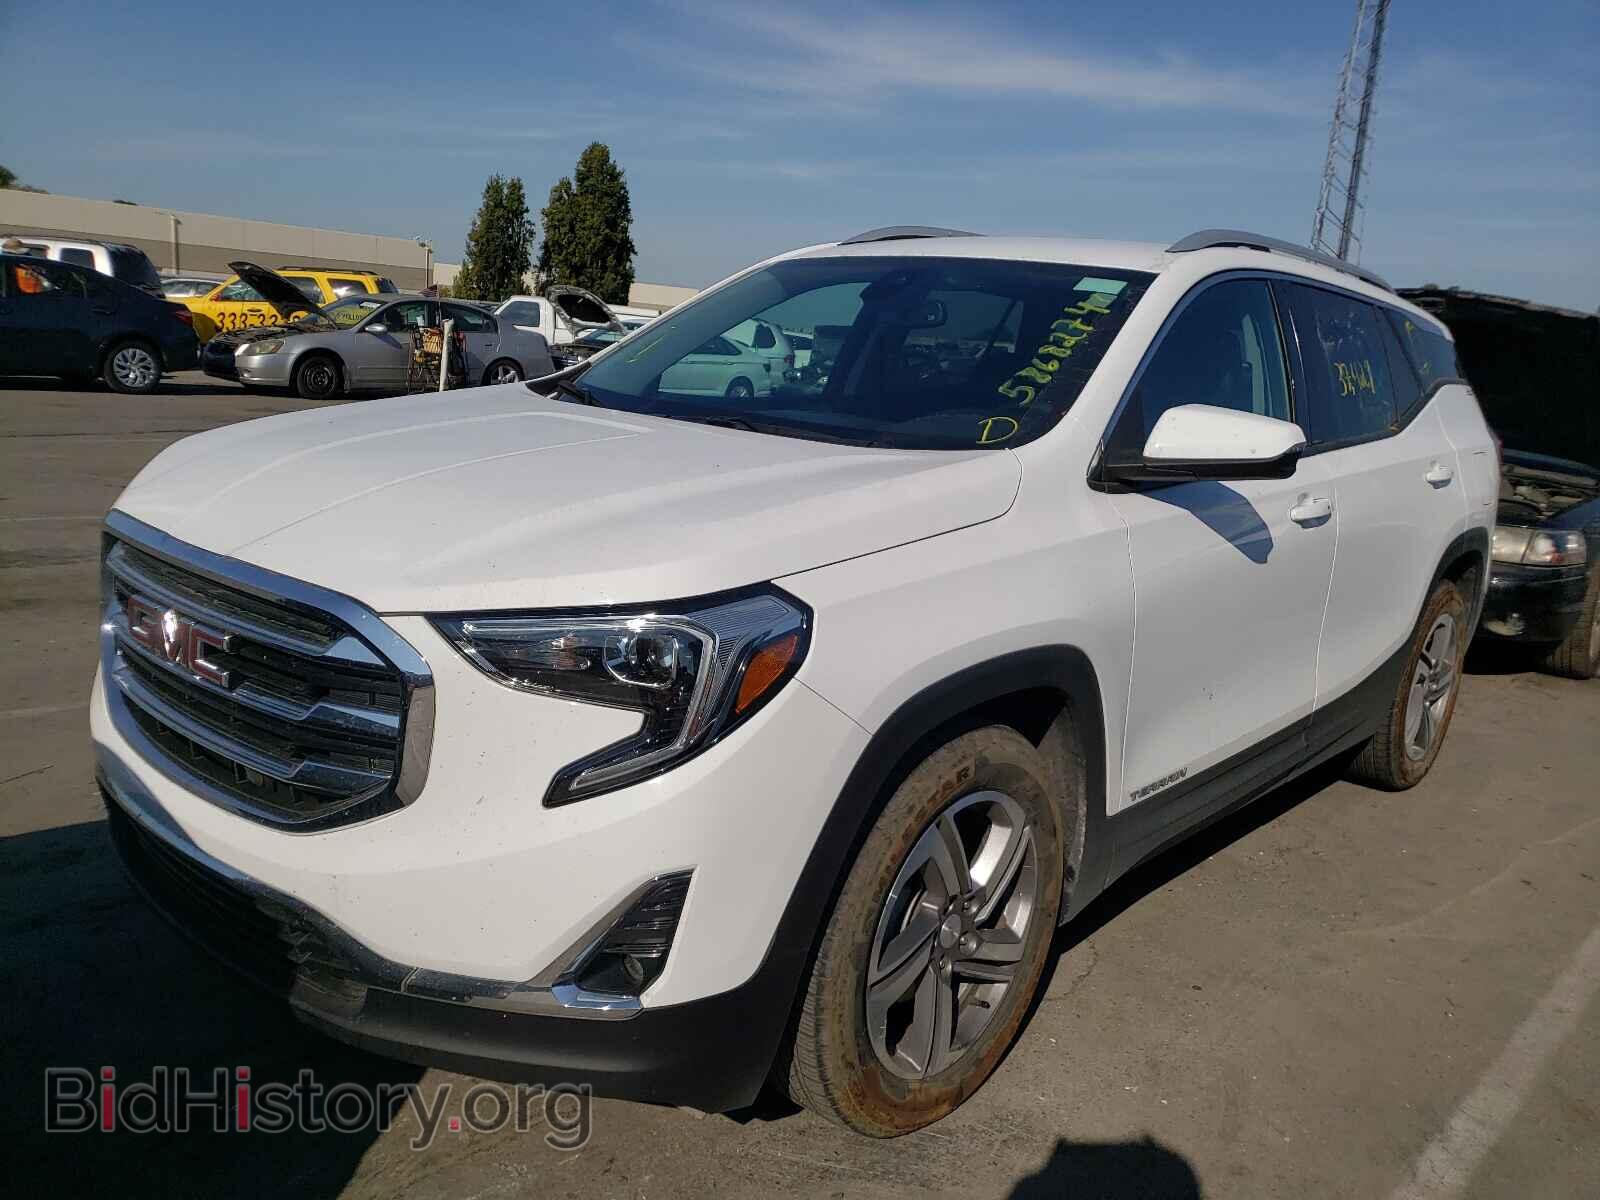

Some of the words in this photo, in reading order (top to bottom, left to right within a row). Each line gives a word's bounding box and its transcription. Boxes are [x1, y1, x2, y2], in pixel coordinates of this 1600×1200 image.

[976, 416, 1019, 444] D
[127, 598, 230, 689] GMC
[1130, 767, 1188, 801] TERRAIN
